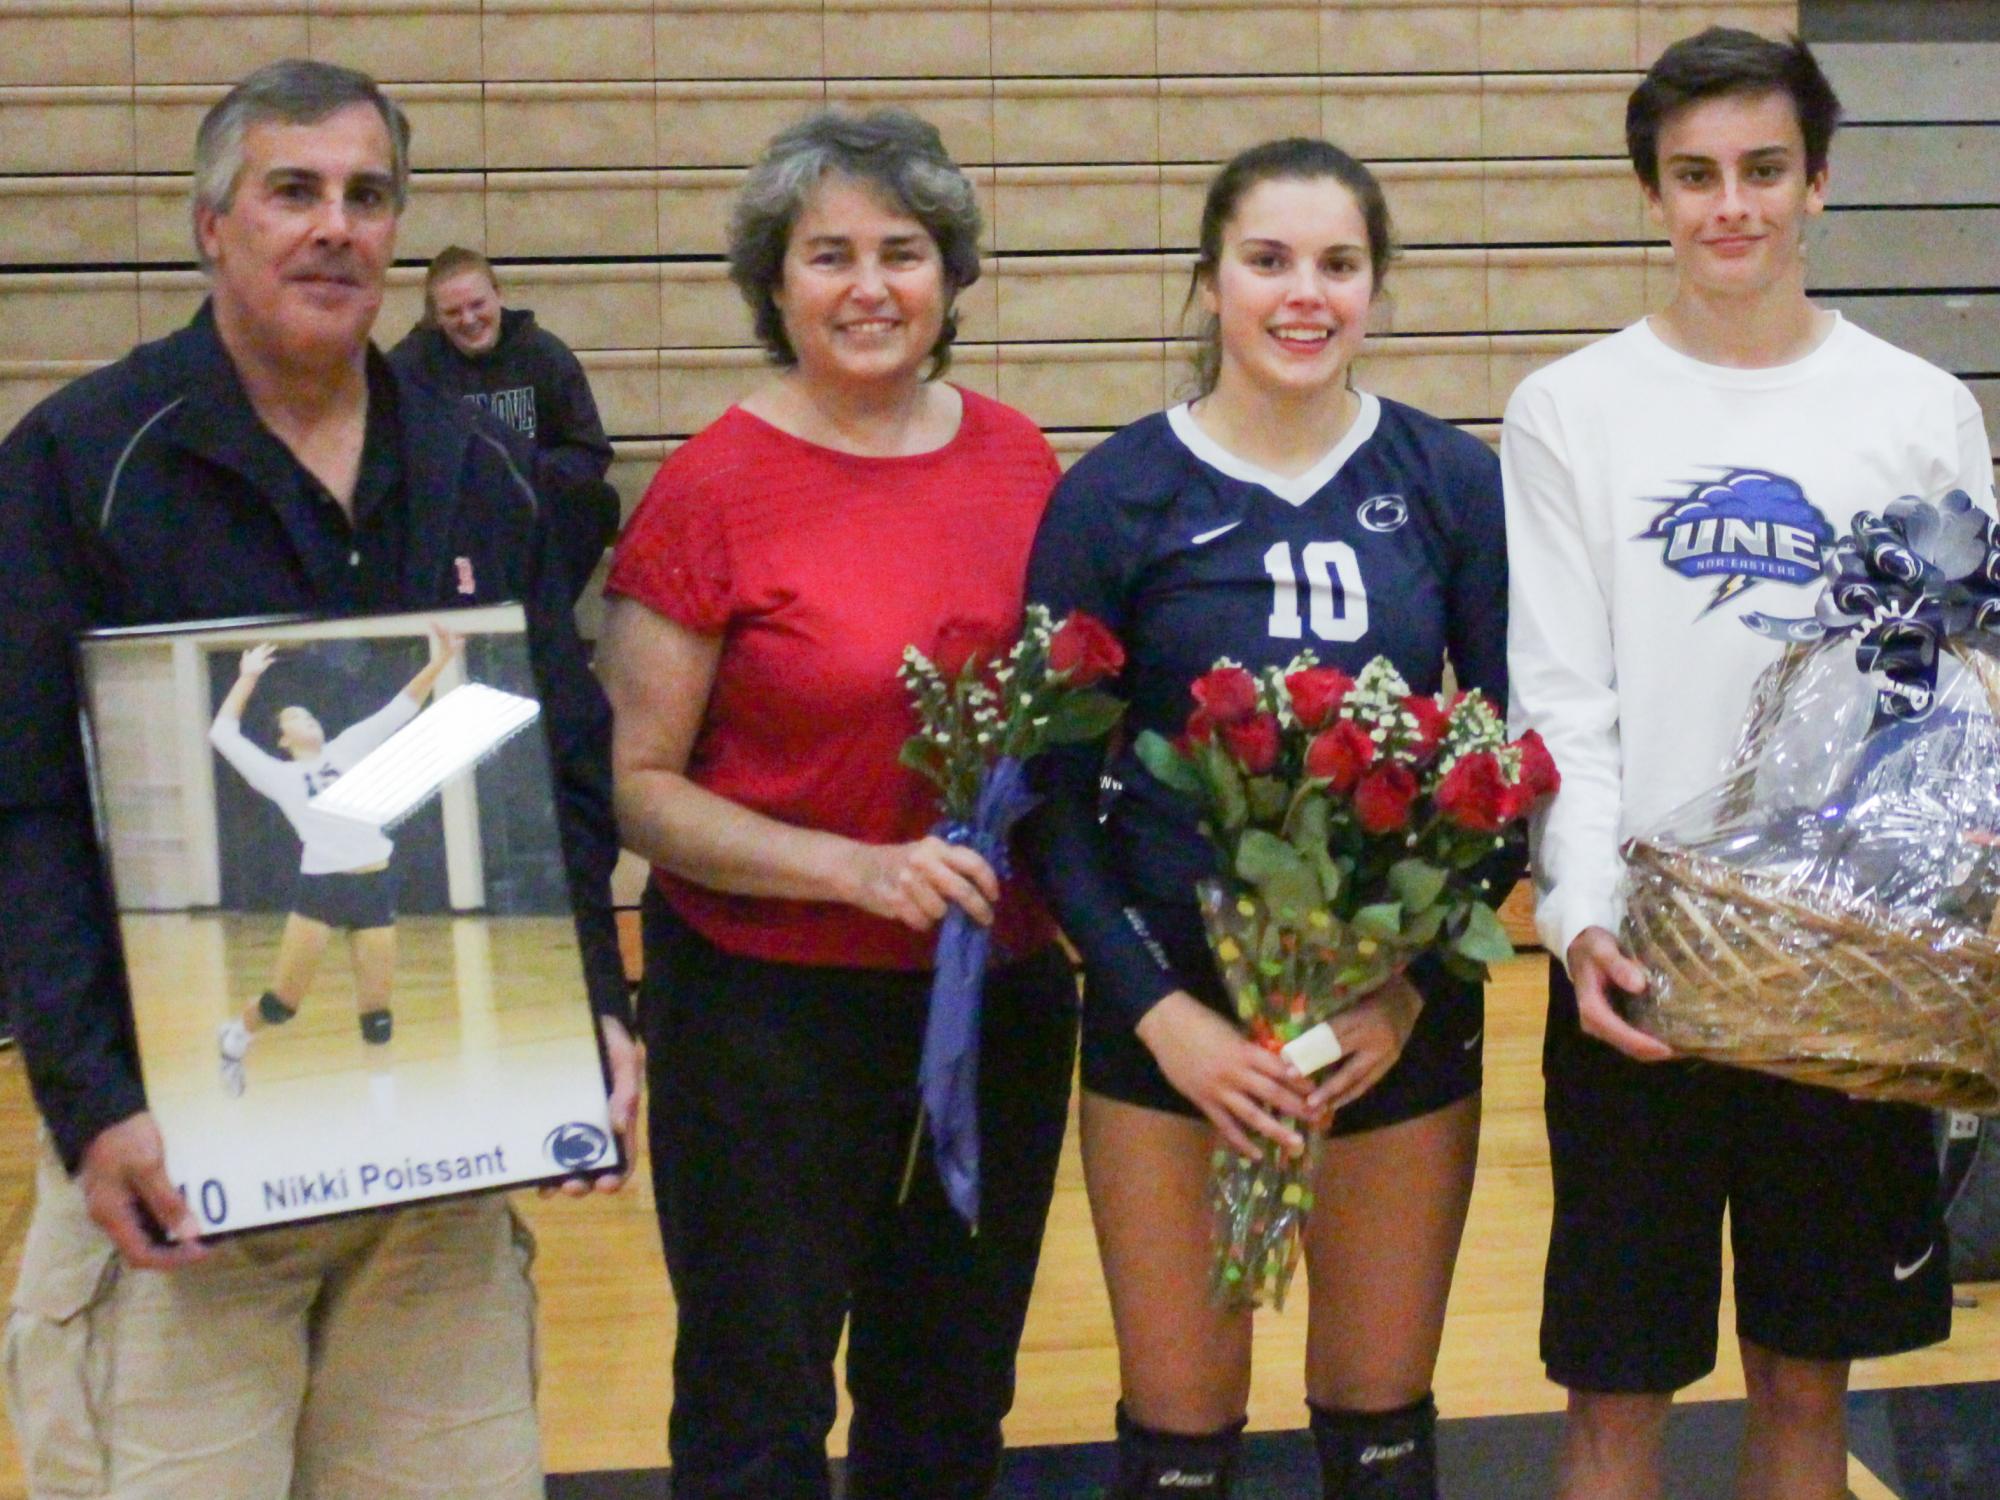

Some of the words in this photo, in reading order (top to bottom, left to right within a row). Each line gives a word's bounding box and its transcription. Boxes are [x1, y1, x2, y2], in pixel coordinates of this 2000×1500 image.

[1668, 518, 1821, 571] UNE
[1264, 541, 1369, 643] 10
[262, 1168, 349, 1211] Nikki
[359, 1145, 507, 1195] Poissant
